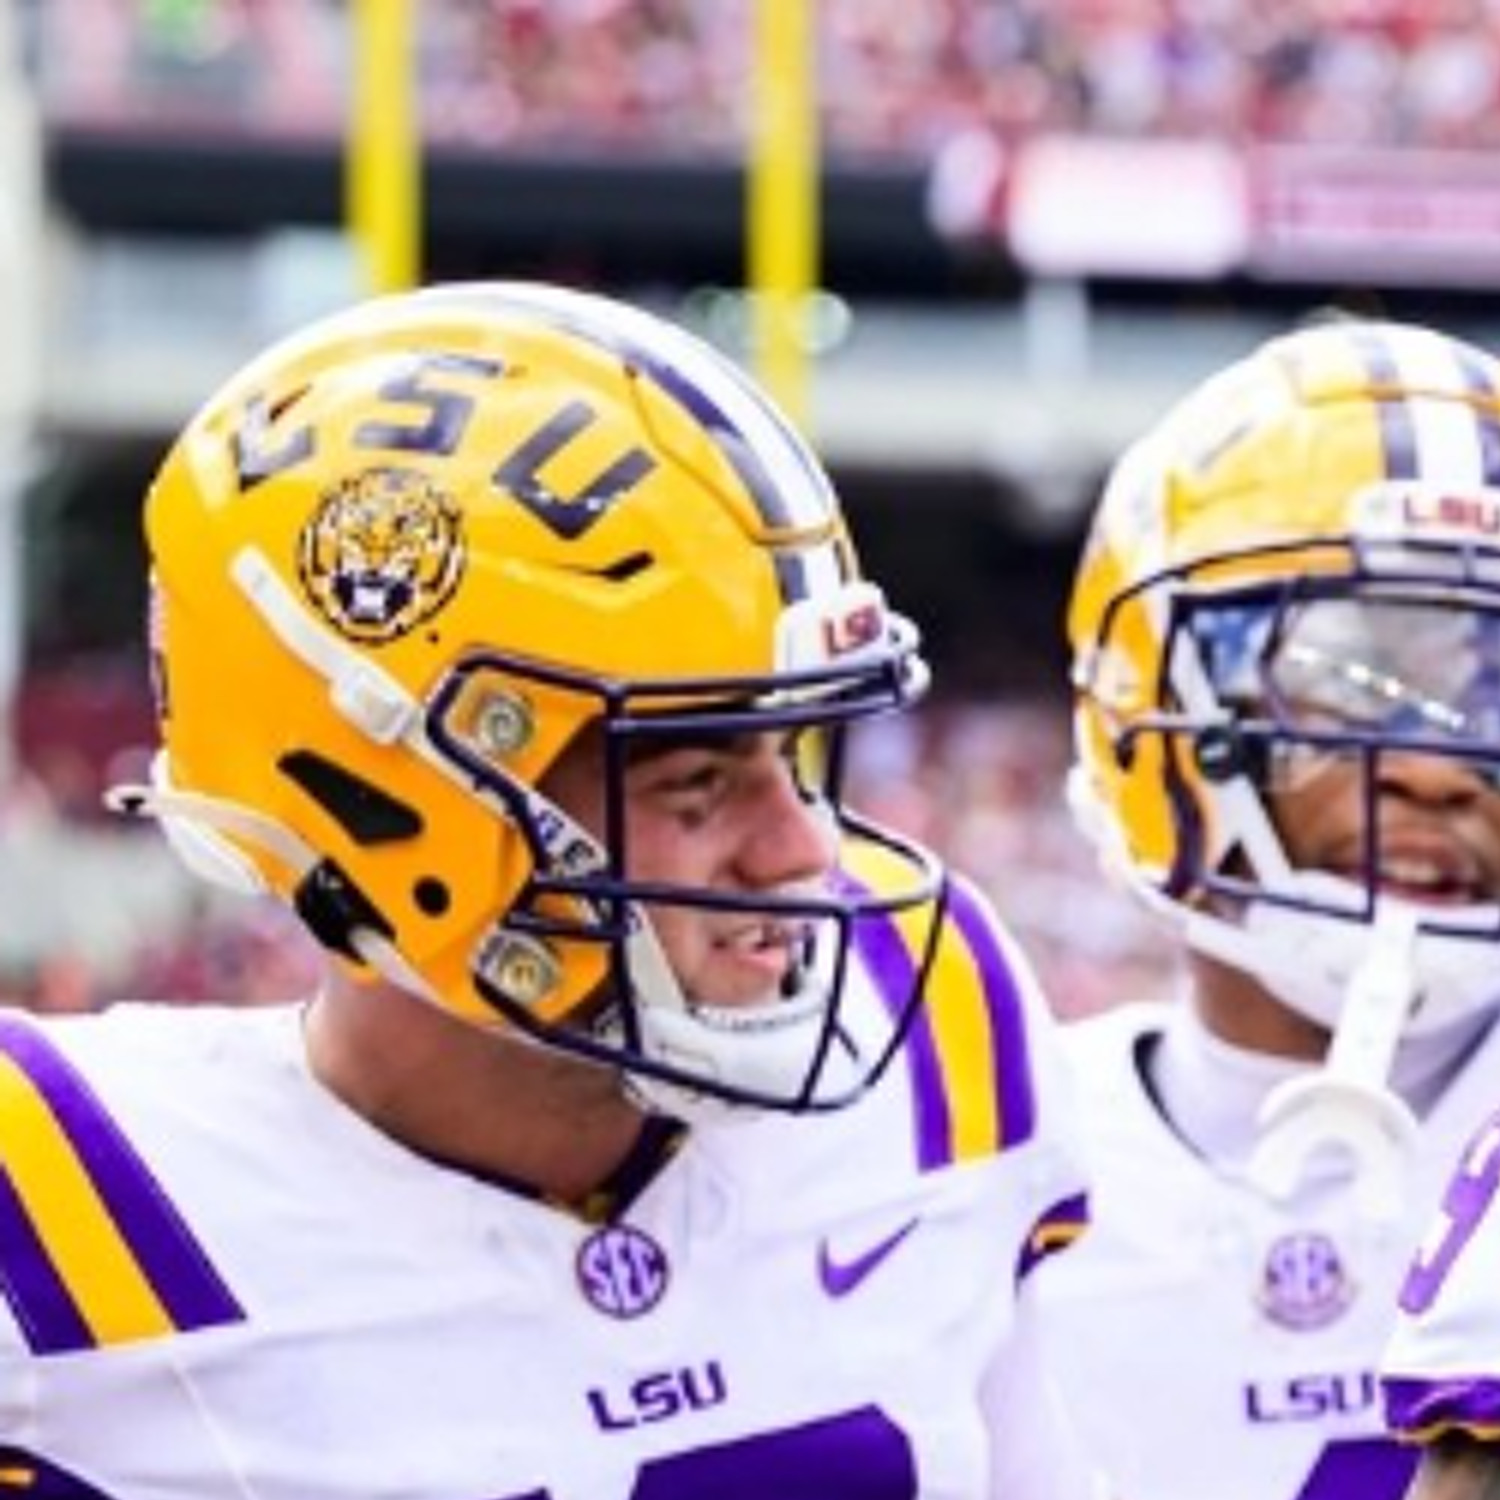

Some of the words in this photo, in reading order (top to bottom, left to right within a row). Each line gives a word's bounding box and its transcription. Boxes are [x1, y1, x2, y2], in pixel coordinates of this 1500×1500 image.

[233, 352, 658, 542] LSU
[586, 1360, 727, 1430] LSU
[1245, 1372, 1376, 1423] LSU
